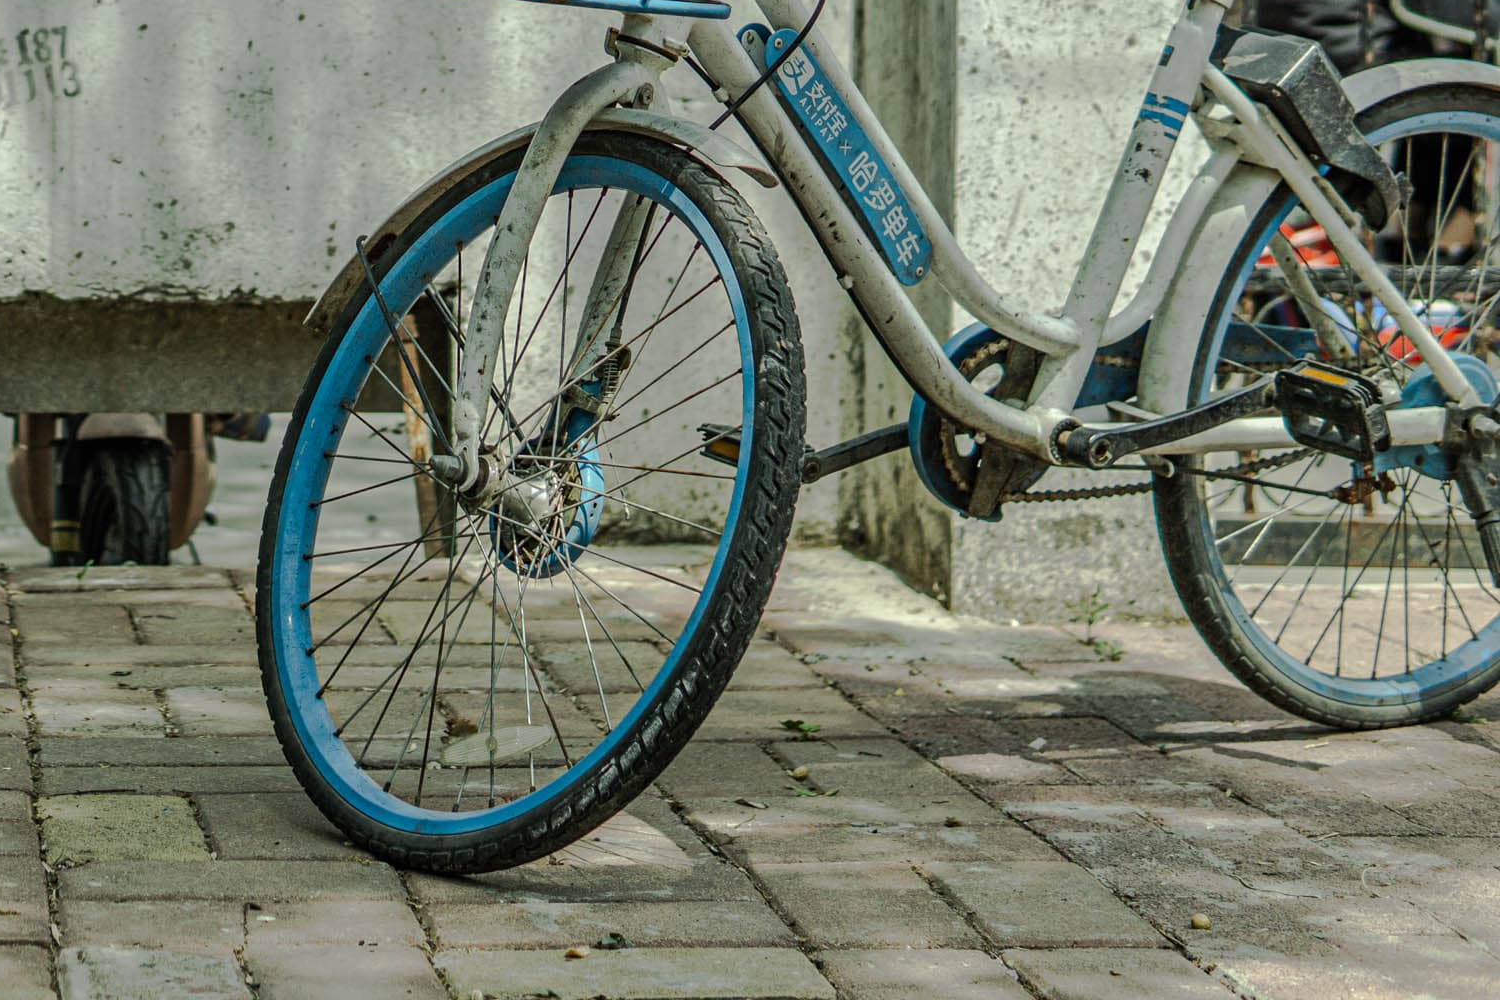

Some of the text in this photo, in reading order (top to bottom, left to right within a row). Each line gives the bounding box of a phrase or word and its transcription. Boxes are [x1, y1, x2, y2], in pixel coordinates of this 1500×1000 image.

[15, 25, 68, 67] 187
[799, 97, 835, 143] ALIPAY
[805, 80, 848, 137] 支付宝
[848, 151, 920, 267] 哈罗单车
